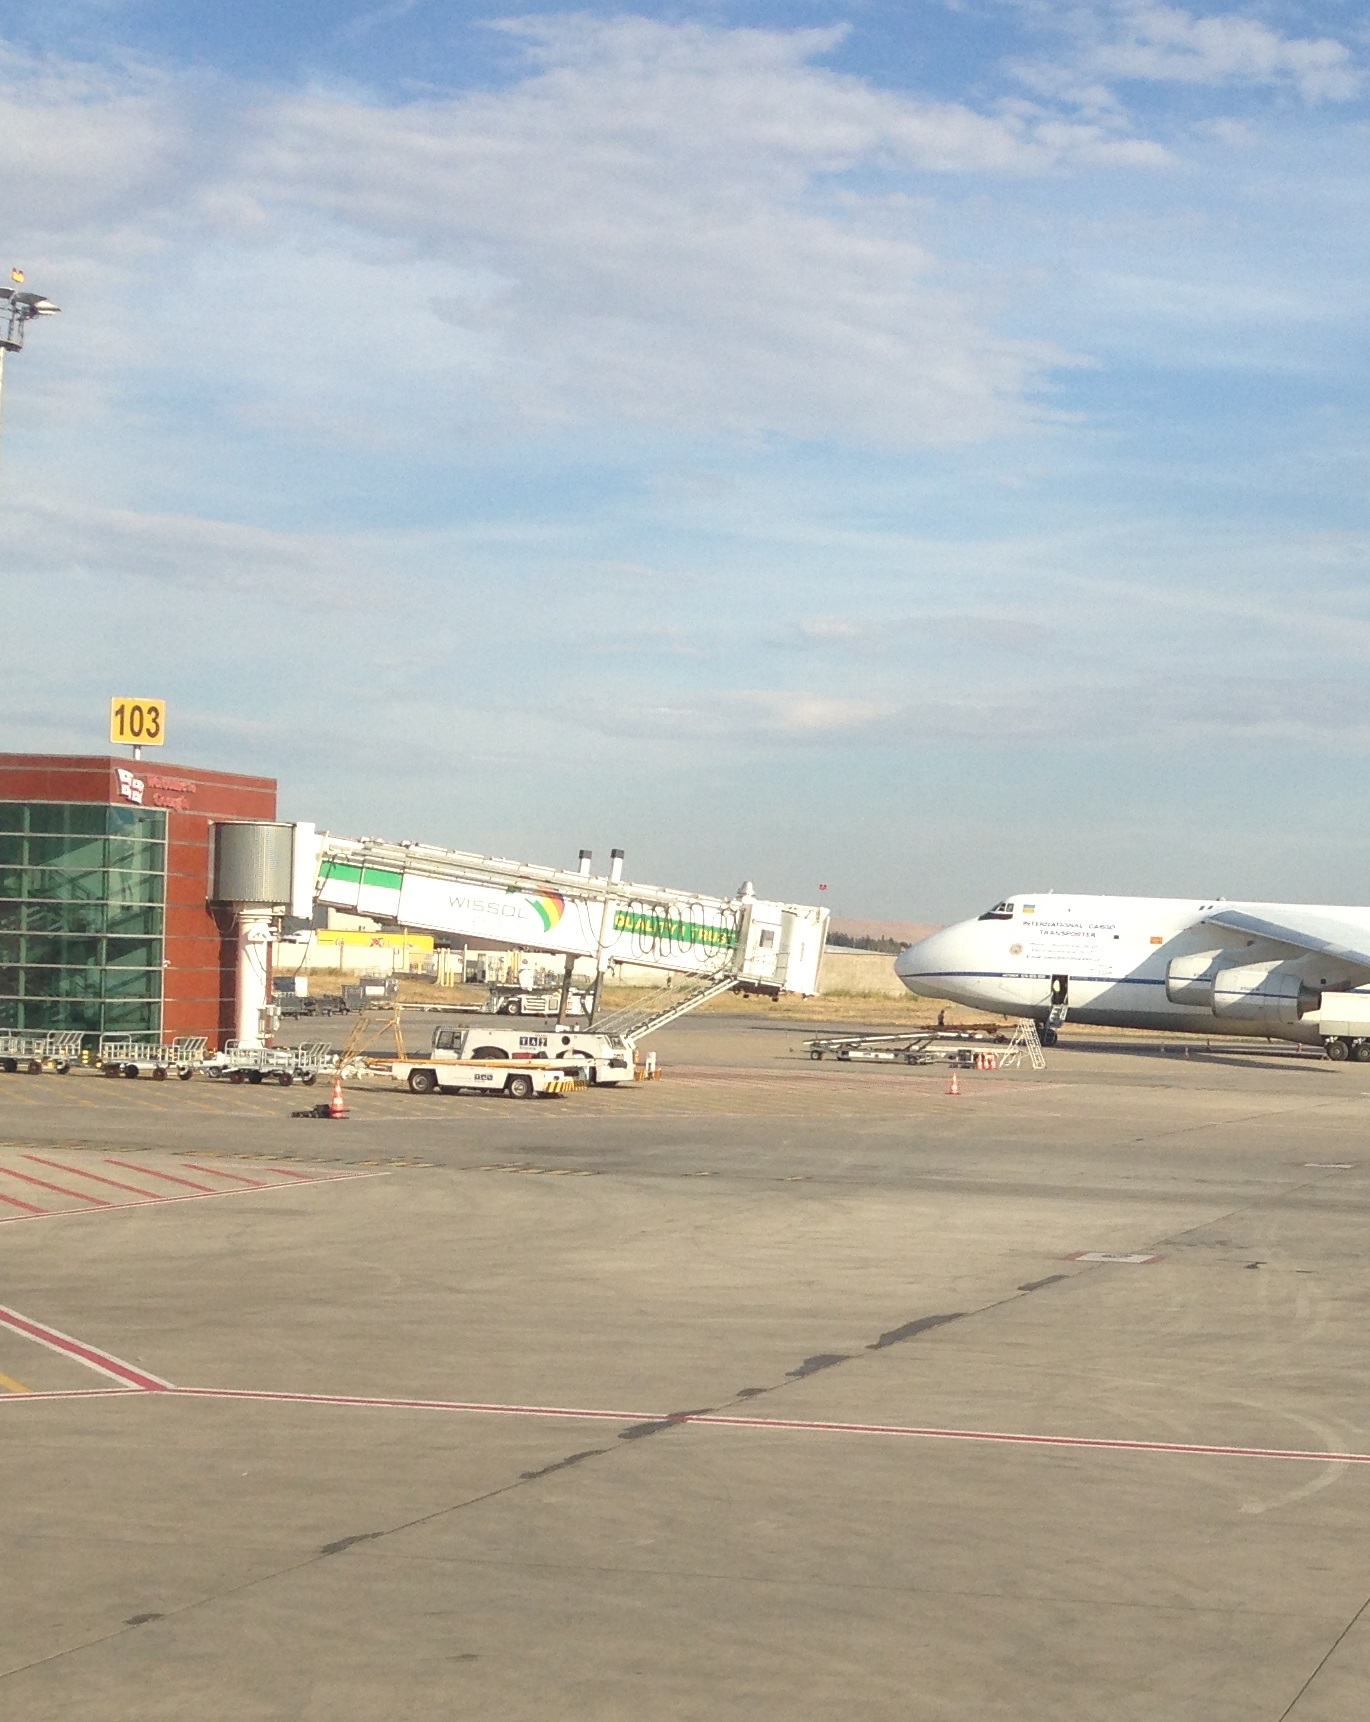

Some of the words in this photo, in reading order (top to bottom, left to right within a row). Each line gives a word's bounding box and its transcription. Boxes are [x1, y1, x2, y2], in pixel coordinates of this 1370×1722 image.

[114, 703, 160, 738] 103
[448, 896, 528, 920] WISSOL
[1022, 920, 1083, 929] INTERNATIONAL
[1088, 922, 1116, 931] CARGO
[1039, 929, 1096, 938] TRANSPORTER
